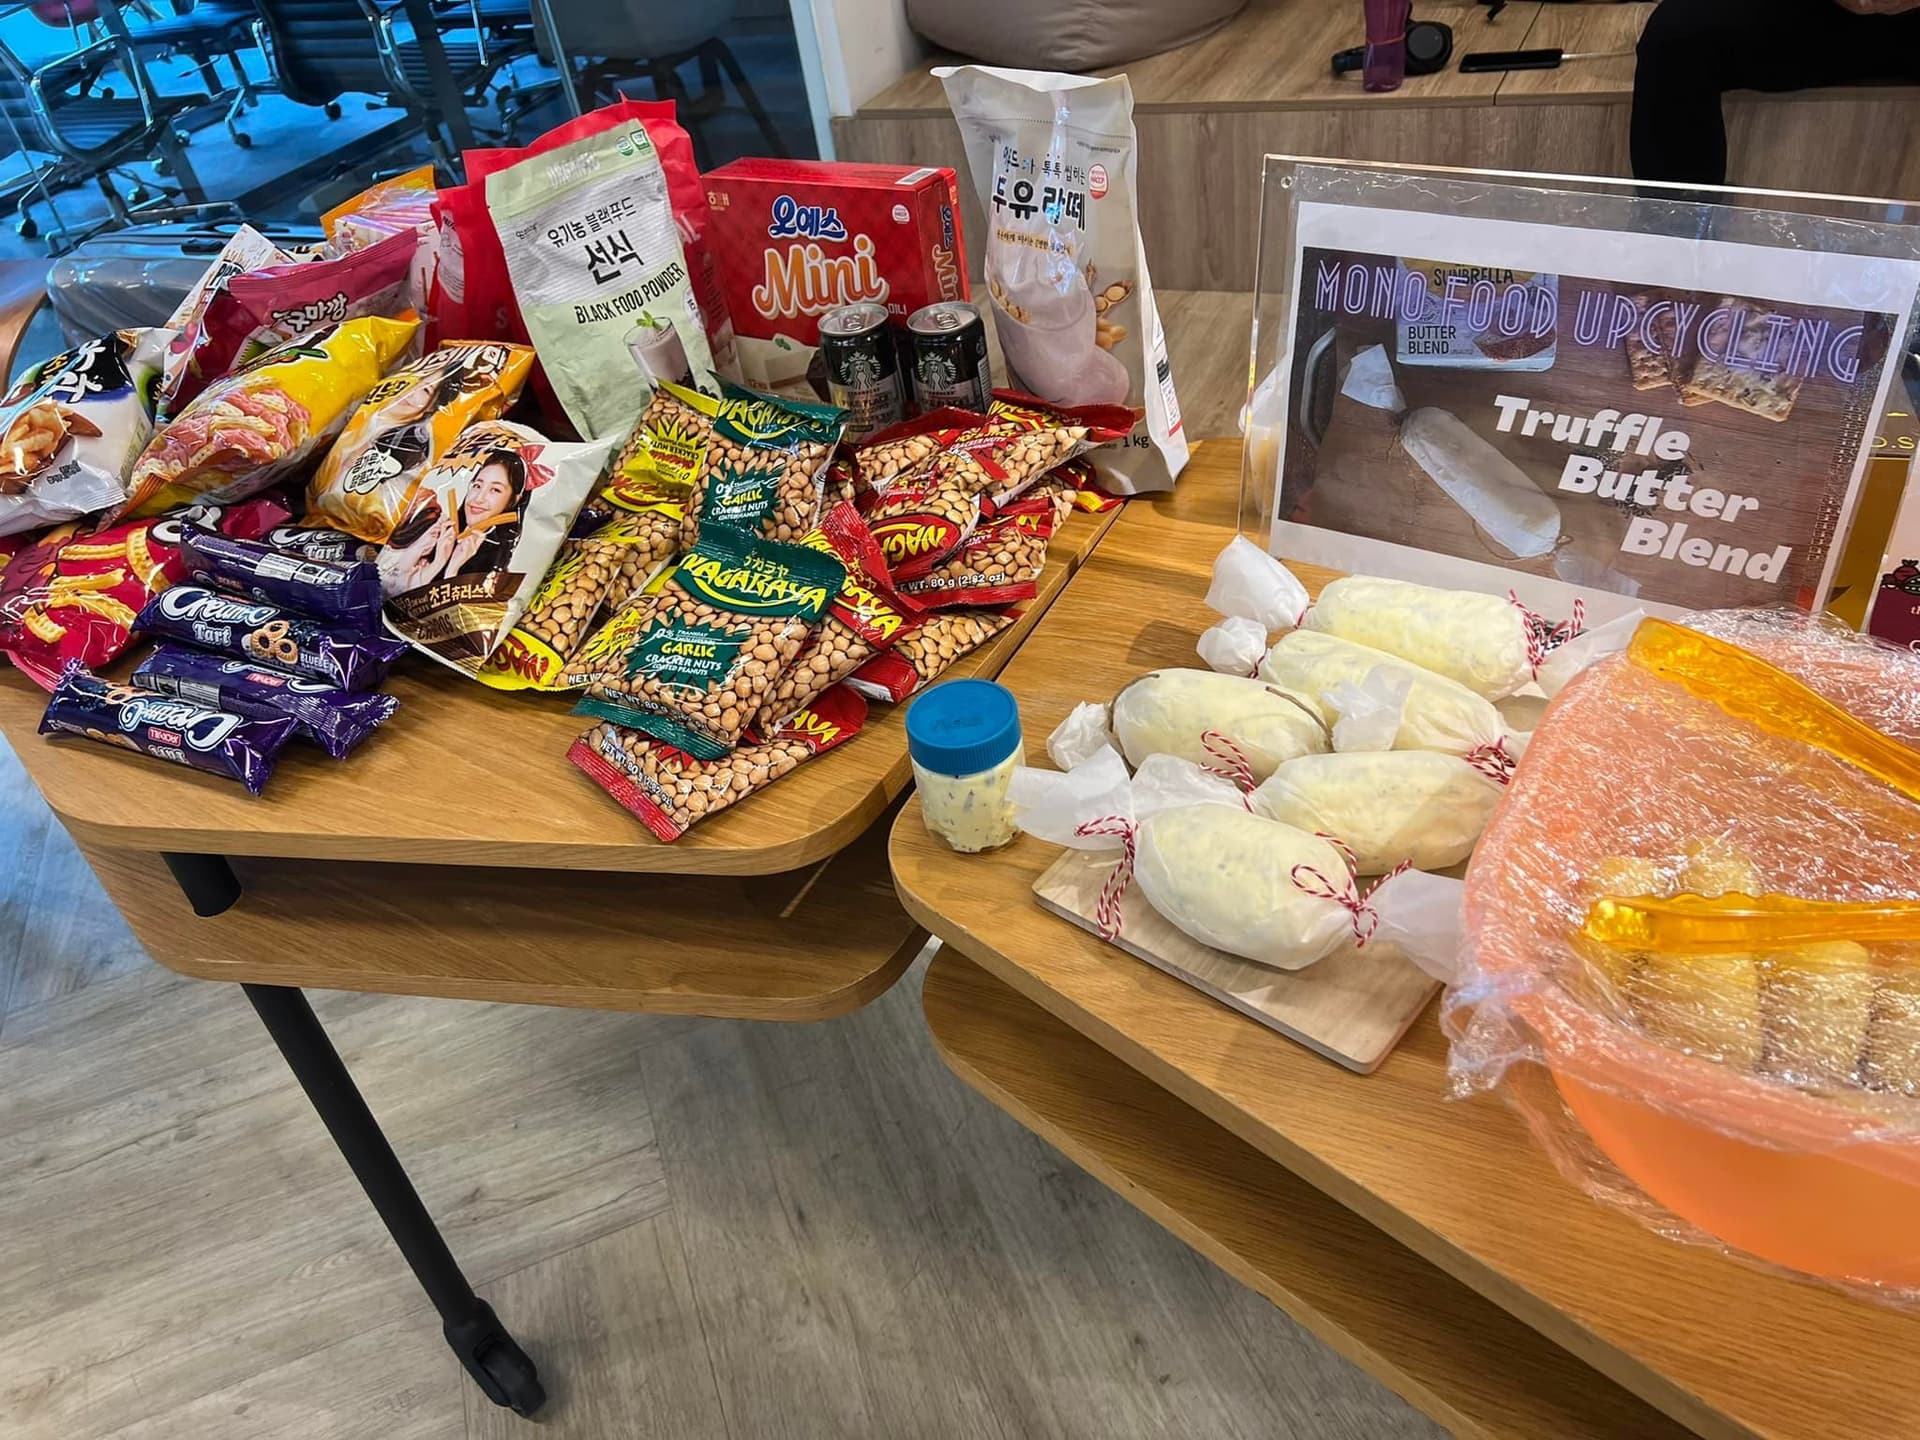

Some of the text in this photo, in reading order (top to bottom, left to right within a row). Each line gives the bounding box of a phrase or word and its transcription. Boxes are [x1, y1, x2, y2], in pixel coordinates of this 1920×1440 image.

[547, 221, 587, 248] 유기농
[585, 197, 637, 233] 블랙푸드
[769, 195, 848, 243] 오예스
[587, 230, 644, 285] 선식
[752, 234, 890, 320] Mini
[574, 261, 686, 325] BLACK FOOD POWDER
[1315, 259, 1864, 384] MONO FOOD UPCYCLING
[1408, 325, 1457, 340] BUTTER
[1408, 340, 1450, 354] BLEND
[1494, 394, 1691, 461] Truffle
[1132, 434, 1149, 450] kg
[1558, 455, 1760, 522] Butter
[748, 501, 769, 513] NUTS
[303, 541, 346, 560] Tart
[1620, 518, 1792, 584] Blend
[680, 552, 829, 615] NAGARAYA
[931, 578, 945, 589] 80
[947, 578, 955, 589] g
[192, 622, 233, 645] Tart
[661, 641, 717, 658] GARLIC
[645, 654, 723, 672] CRACKER NUTS
[678, 666, 708, 676] PEANUTS
[568, 674, 590, 684] NET
[604, 687, 623, 699] NET
